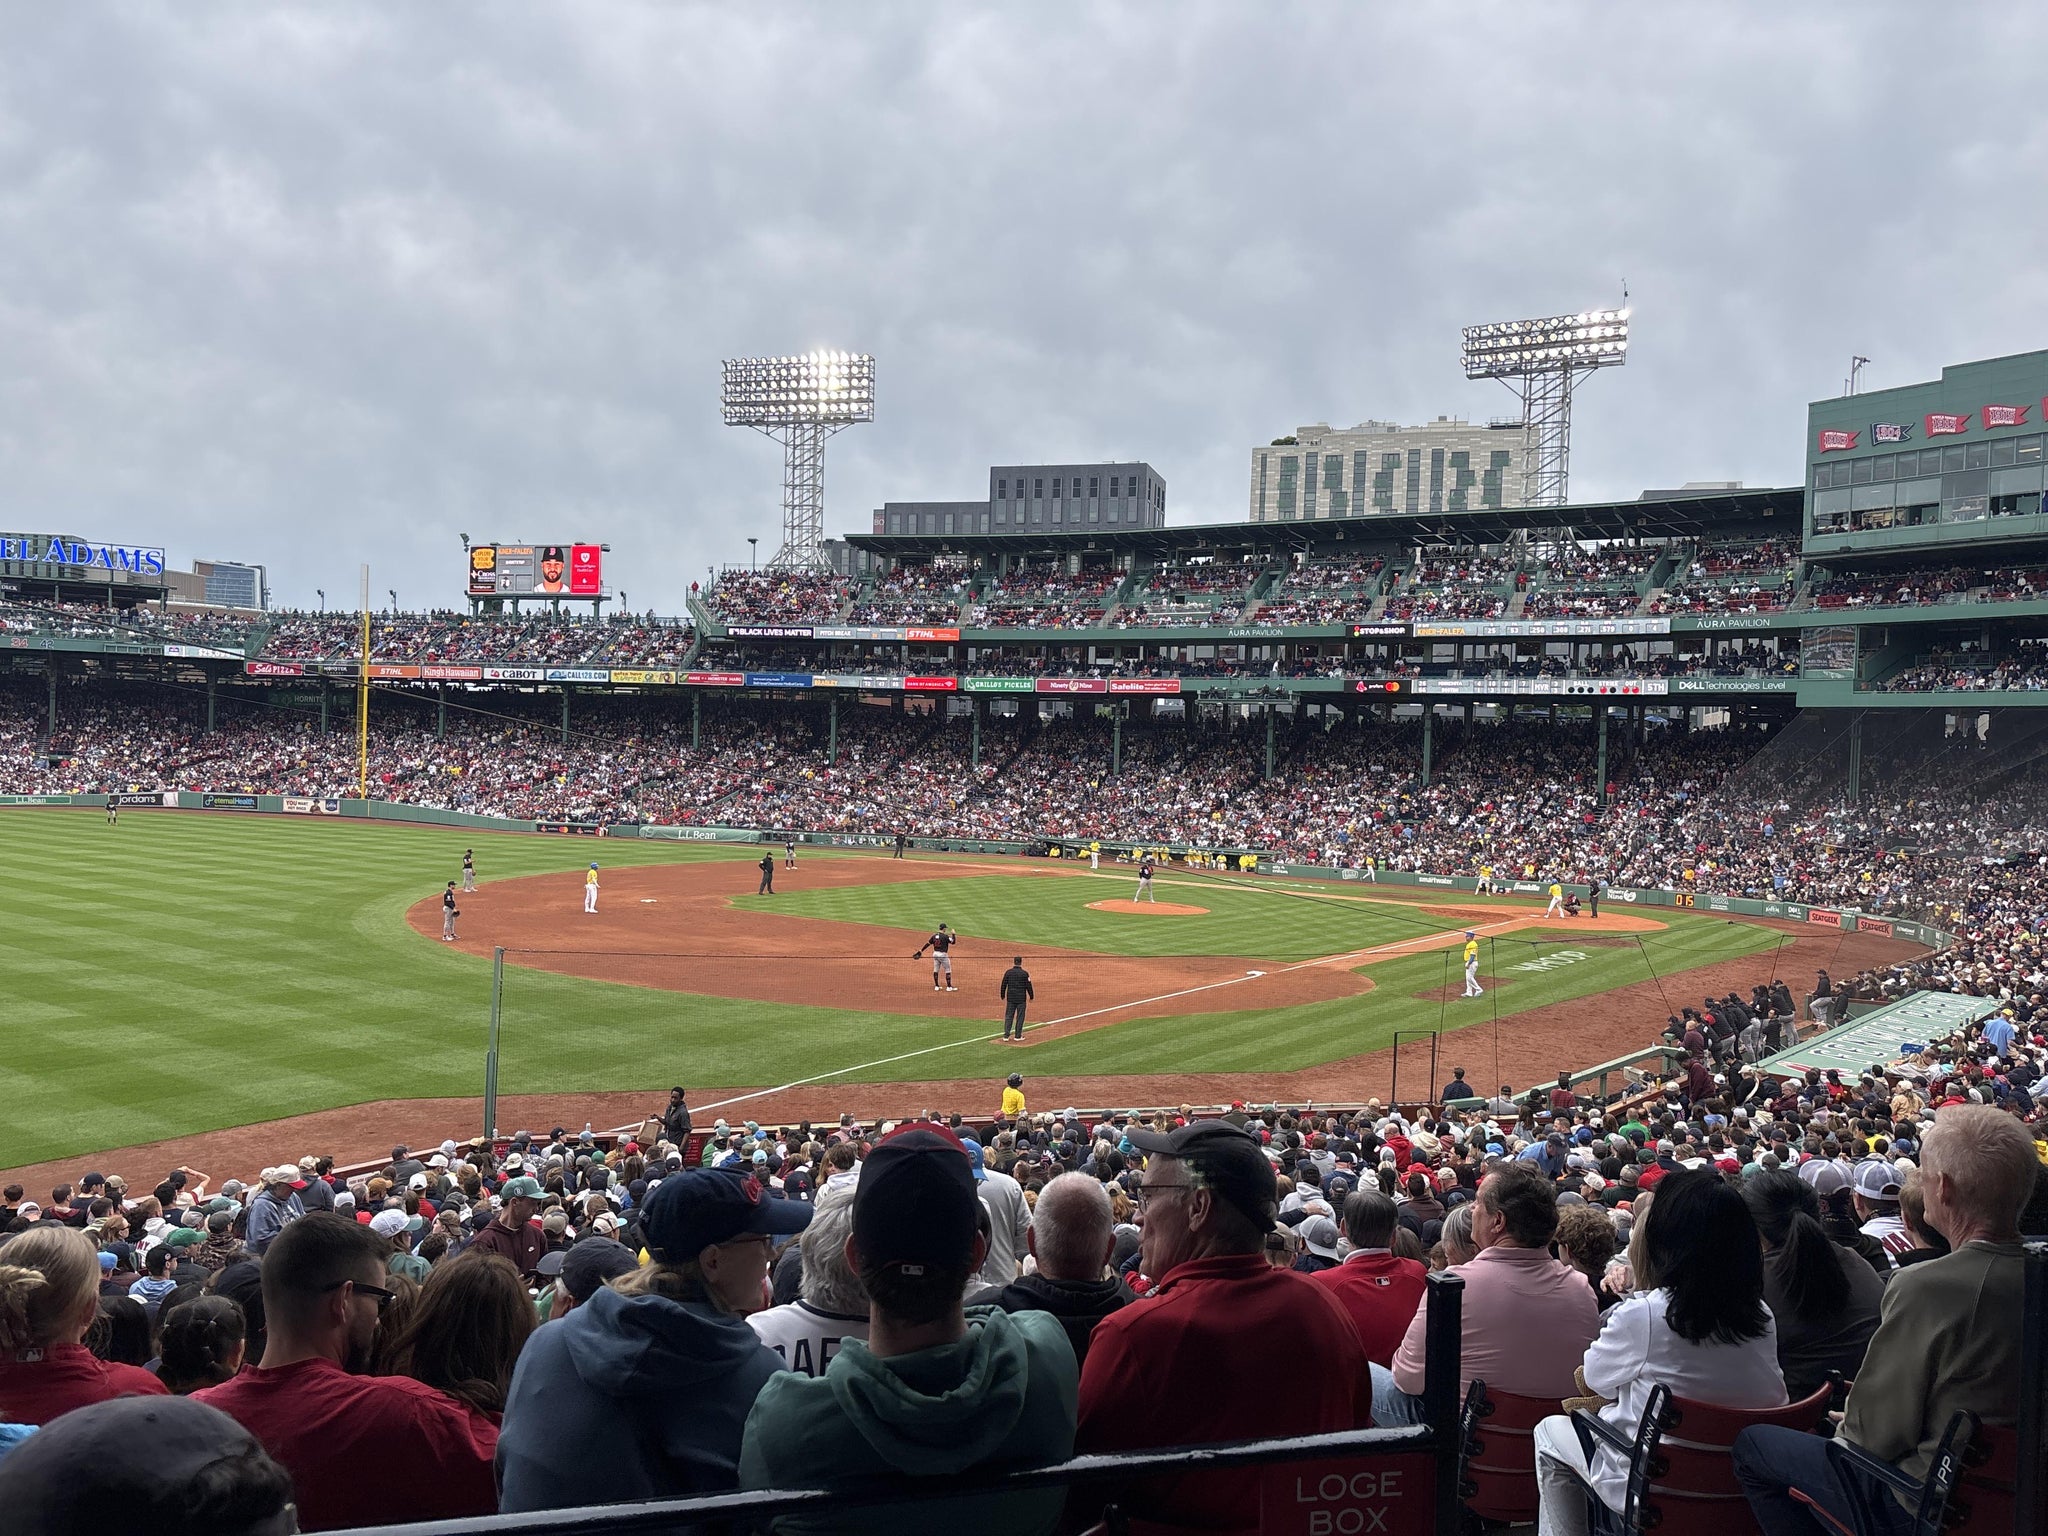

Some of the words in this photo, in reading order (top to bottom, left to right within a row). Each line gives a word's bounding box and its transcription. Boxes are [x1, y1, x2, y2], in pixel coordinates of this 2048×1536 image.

[42, 537, 162, 576] ADAMS
[1728, 619, 1770, 627] PAVILION
[740, 628, 762, 636] BLACK
[763, 628, 781, 636] LIVES
[782, 629, 812, 637] MATTER
[908, 630, 935, 638] STIHL
[11, 637, 28, 648] 34
[40, 639, 54, 649] 42
[273, 665, 295, 674] PIZZA
[380, 667, 403, 675] STIHL
[424, 668, 445, 678] King's
[445, 668, 479, 677] Hawaiian
[567, 671, 607, 680] CALL128.COM
[1647, 683, 1664, 691] 5TH
[1678, 681, 1704, 690] DELL
[1704, 681, 1761, 692] Technologies
[1762, 681, 1786, 690] Level
[678, 829, 717, 839] L.L.Bean
[1418, 877, 1453, 885] smartwater
[1676, 894, 1681, 906] 0
[1811, 912, 1839, 925] SEATGEEK
[1860, 921, 1890, 935] SEATGEEK
[1937, 1455, 1953, 1484] PP
[1296, 1470, 1403, 1502] LOGE
[1309, 1506, 1389, 1536] BOX
